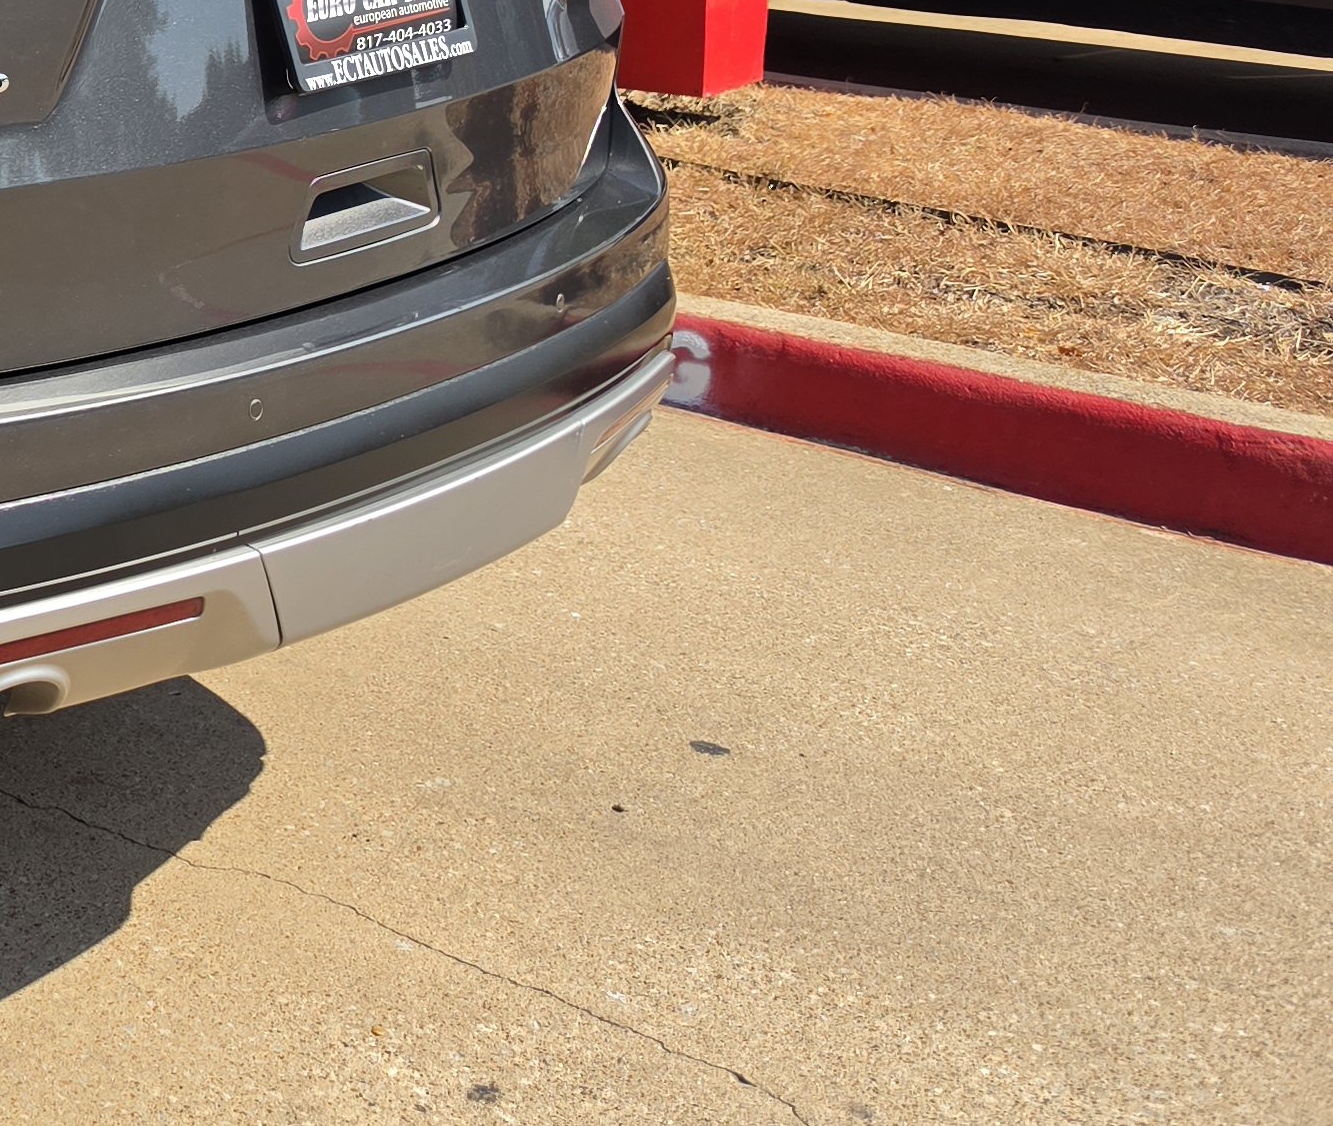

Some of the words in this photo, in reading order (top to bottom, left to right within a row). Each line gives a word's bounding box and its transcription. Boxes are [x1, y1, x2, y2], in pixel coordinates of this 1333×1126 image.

[353, 7, 398, 26] european
[356, 19, 452, 51] 817-404-4033
[305, 35, 474, 91] www.ECTAUTOSALES.com
